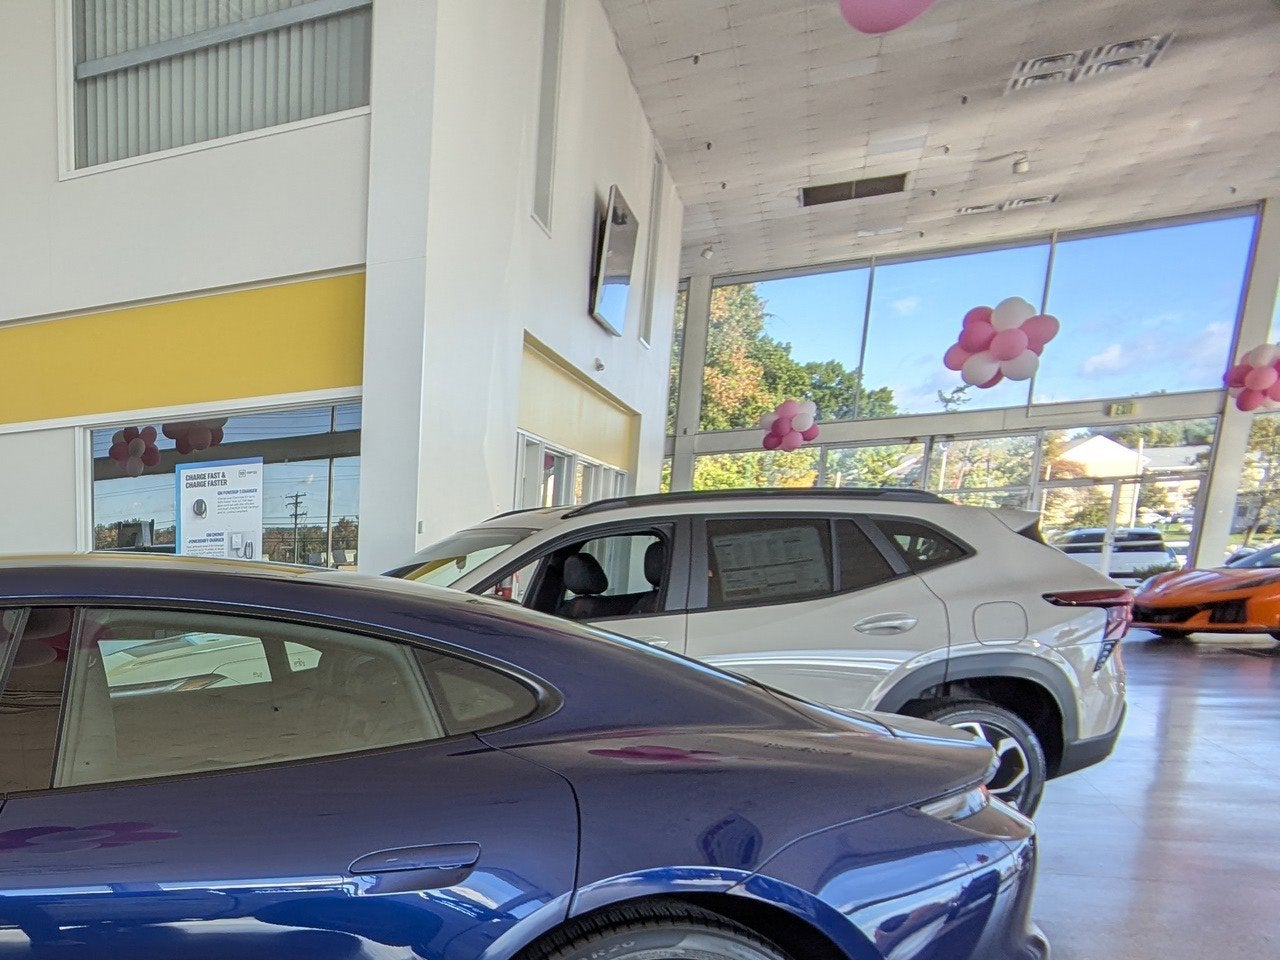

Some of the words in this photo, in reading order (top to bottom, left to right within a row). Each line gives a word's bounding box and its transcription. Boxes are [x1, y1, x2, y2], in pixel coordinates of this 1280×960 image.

[185, 473, 206, 481] CHARGE
[207, 471, 220, 480] FAST
[221, 471, 227, 479] &
[185, 480, 207, 489] CHARGE
[207, 479, 228, 488] FASTER
